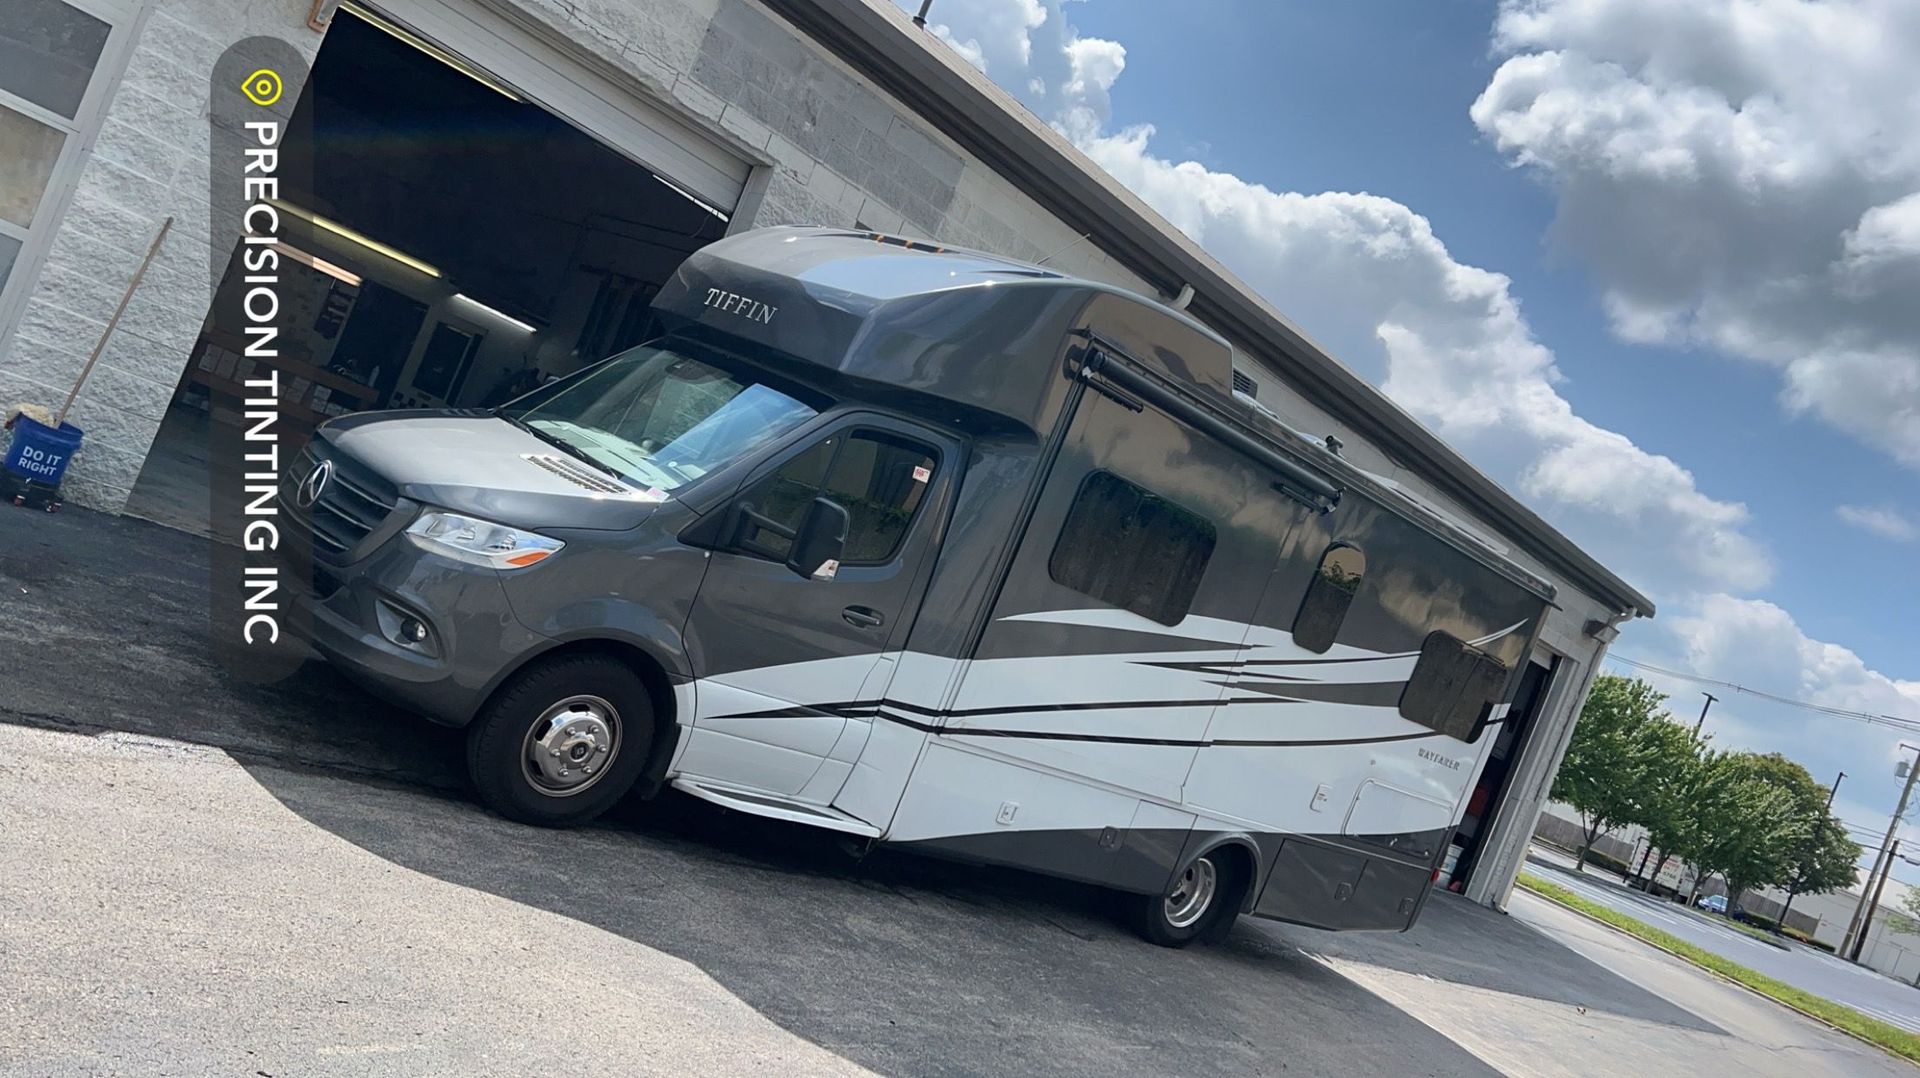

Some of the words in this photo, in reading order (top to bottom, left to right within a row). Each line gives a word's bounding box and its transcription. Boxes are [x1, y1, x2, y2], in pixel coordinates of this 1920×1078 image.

[704, 287, 778, 325] TIFFIN
[17, 457, 57, 476] RIGHT
[22, 445, 44, 461] DO
[46, 454, 62, 466] IT
[1418, 747, 1460, 771] WAYFARER
